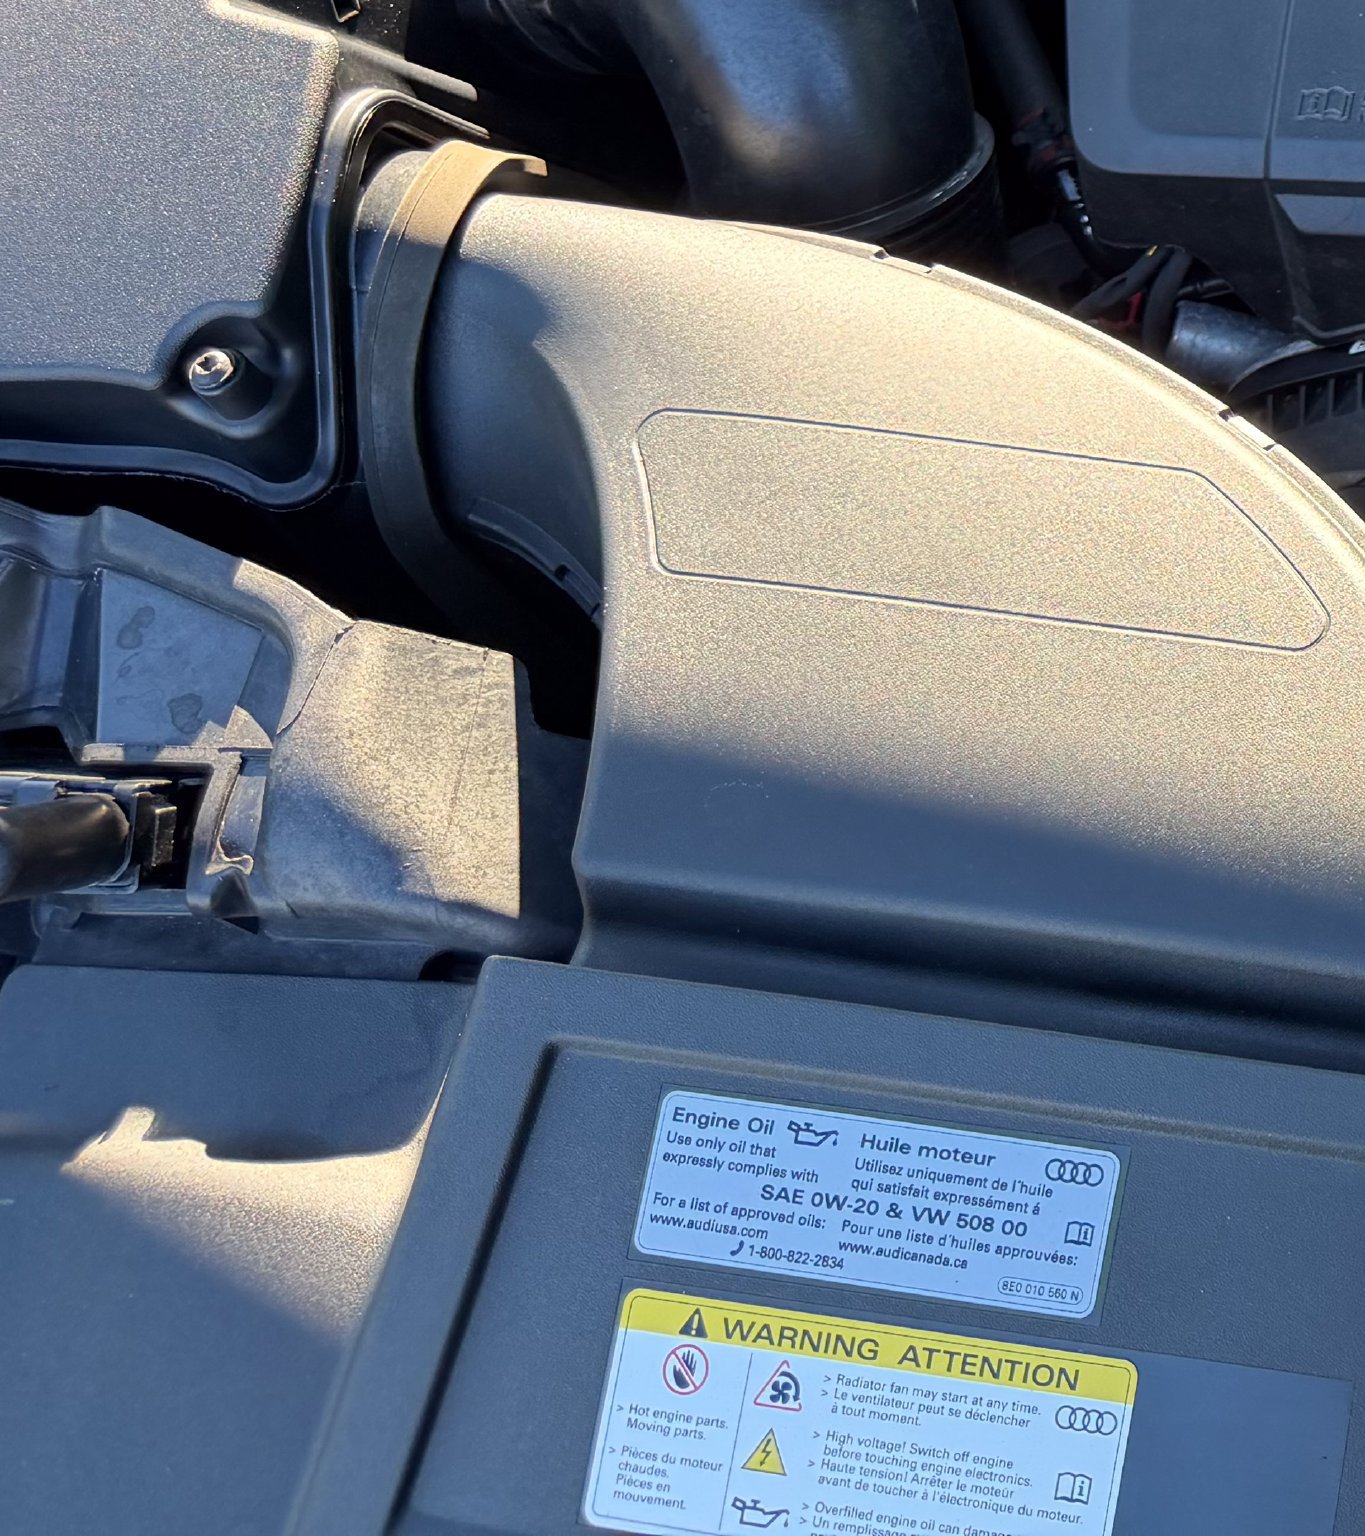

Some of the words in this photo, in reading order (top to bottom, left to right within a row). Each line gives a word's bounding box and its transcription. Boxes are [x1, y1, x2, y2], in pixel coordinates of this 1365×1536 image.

[672, 1107, 740, 1130] Engine
[748, 1117, 775, 1135] Oil
[666, 1130, 692, 1145] Use
[696, 1136, 726, 1153] only
[729, 1142, 745, 1154] oil
[750, 1144, 776, 1158] that
[860, 1133, 911, 1155] Huile
[918, 1144, 996, 1166] moteur
[663, 1151, 725, 1172] expressly
[728, 1161, 788, 1179] complies
[791, 1168, 819, 1183] with
[855, 1157, 903, 1176] Utilisez
[907, 1167, 988, 1190] uniquement
[992, 1178, 1008, 1192] de
[653, 1192, 675, 1206] For
[678, 1199, 686, 1208] a
[690, 1197, 709, 1212] list
[713, 1202, 728, 1214] of
[731, 1205, 794, 1224] approved
[798, 1214, 826, 1229] oils:
[760, 1184, 804, 1205] SAE
[811, 1192, 879, 1215] 0W-20
[886, 1202, 903, 1220] &
[912, 1206, 951, 1226] VW
[956, 1213, 995, 1232] 508
[1001, 1219, 1027, 1237] 00
[851, 1178, 874, 1192] qui
[877, 1181, 929, 1200] satisfait
[933, 1190, 1028, 1214] expressément
[650, 1213, 768, 1239] www.audiusa.com
[749, 1245, 844, 1269] 1-800-822-2834
[838, 1241, 968, 1269] www.audicanada.ca
[842, 1220, 874, 1236] Pour
[877, 1227, 901, 1240] une
[906, 1229, 933, 1245] liste
[995, 1244, 1078, 1266] approuvées:
[1001, 1280, 1022, 1293] 8E0
[1025, 1283, 1045, 1296] 010
[1048, 1286, 1067, 1300] 560
[1070, 1290, 1080, 1302] N
[724, 1318, 879, 1360] WARNING
[897, 1345, 1080, 1390] ATTENTION
[834, 1387, 848, 1400] Le
[851, 1393, 914, 1410] ventilateur
[917, 1403, 945, 1416] peut
[948, 1407, 961, 1418] se
[965, 1408, 1031, 1428] déclencher
[836, 1373, 886, 1392] Radiator
[890, 1381, 909, 1395] fan
[912, 1387, 938, 1402] may
[941, 1391, 968, 1404] start
[972, 1396, 983, 1407] at
[986, 1399, 1008, 1412] any
[1011, 1400, 1041, 1416] time.
[626, 1417, 670, 1437] Moving
[674, 1427, 706, 1441] parts.
[628, 1404, 649, 1416] Hot
[652, 1410, 693, 1425] engine
[696, 1416, 728, 1430] parts.
[831, 1402, 838, 1414] à
[842, 1404, 865, 1418] tout
[868, 1409, 921, 1426] moment.
[621, 1446, 658, 1462] Pièces
[661, 1451, 676, 1465] du
[680, 1457, 723, 1471] moteur
[823, 1444, 861, 1461] before
[864, 1452, 918, 1472] touching
[920, 1460, 962, 1477] engine
[965, 1468, 1033, 1488] electronics.
[825, 1430, 854, 1446] High
[857, 1436, 906, 1453] voltage!
[909, 1443, 950, 1460] Switch
[953, 1450, 970, 1462] off
[972, 1455, 1013, 1471] engine
[615, 1474, 653, 1490] Pièces
[656, 1481, 670, 1493] en
[618, 1461, 669, 1478] chaudes.
[820, 1458, 855, 1475] Haute
[859, 1465, 908, 1483] tension!
[910, 1474, 952, 1490] Arrêter
[956, 1481, 967, 1492] le
[613, 1490, 686, 1510] mouvement.
[817, 1475, 851, 1489] avant
[854, 1480, 869, 1492] de
[872, 1483, 918, 1499] toucher
[921, 1489, 929, 1501] à
[932, 1491, 1015, 1515] l'électronique
[1017, 1505, 1034, 1517] du
[1037, 1508, 1083, 1526] moteur.
[812, 1515, 829, 1529] Un
[814, 1501, 874, 1521] Overfilled
[876, 1514, 917, 1528] engine
[920, 1519, 936, 1531] oil
[938, 1524, 960, 1536] can
